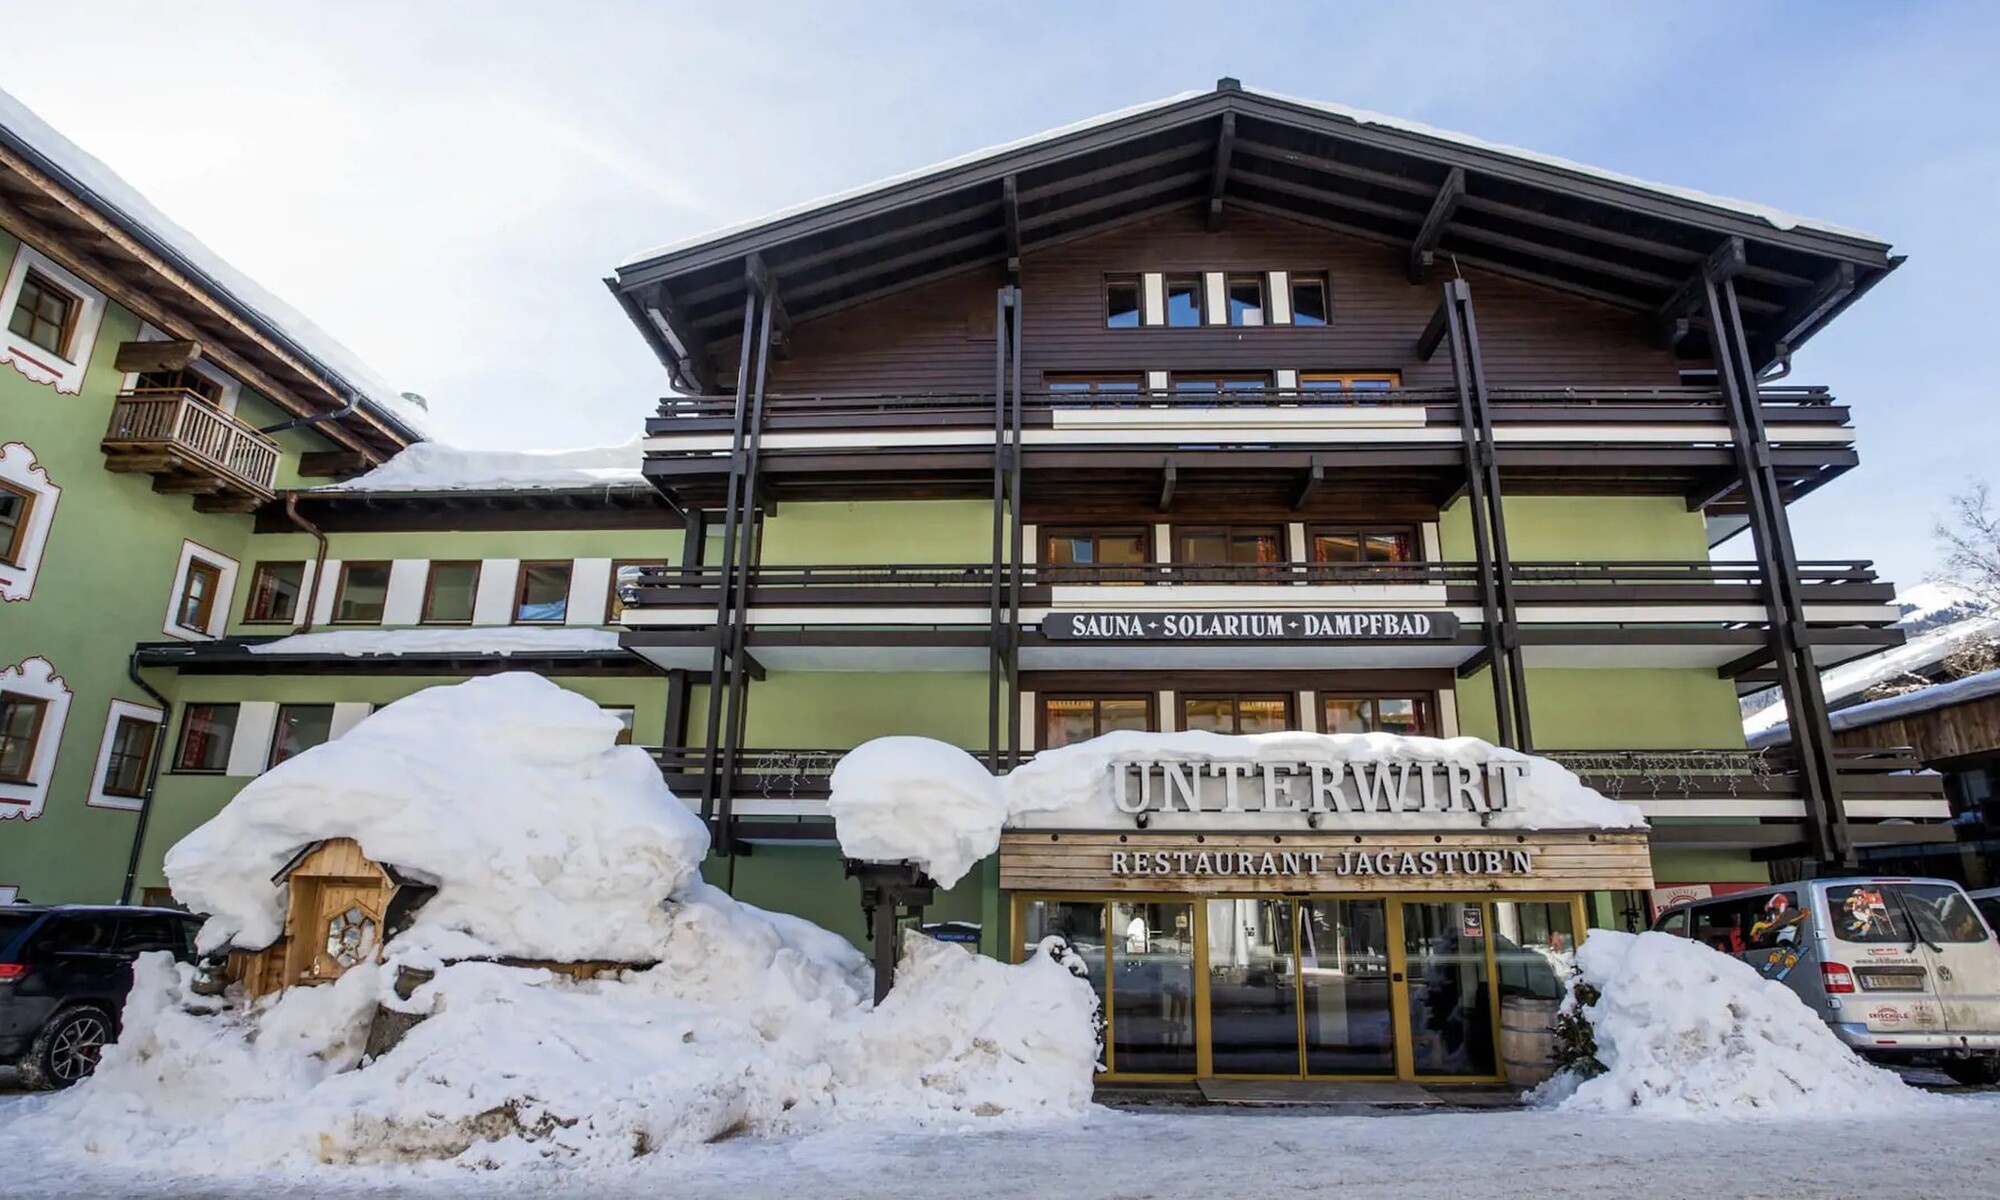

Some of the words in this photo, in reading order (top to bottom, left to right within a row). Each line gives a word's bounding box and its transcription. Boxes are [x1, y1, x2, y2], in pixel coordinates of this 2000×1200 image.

[1072, 614, 1144, 637] SAUNA
[1163, 614, 1284, 637] SOLARIUM
[1304, 613, 1431, 636] DAMPFBAD
[1112, 760, 1531, 814] UNTERWIRT
[1111, 850, 1323, 876] RESTAURANT
[1337, 849, 1532, 876] JAGASTUB'N
